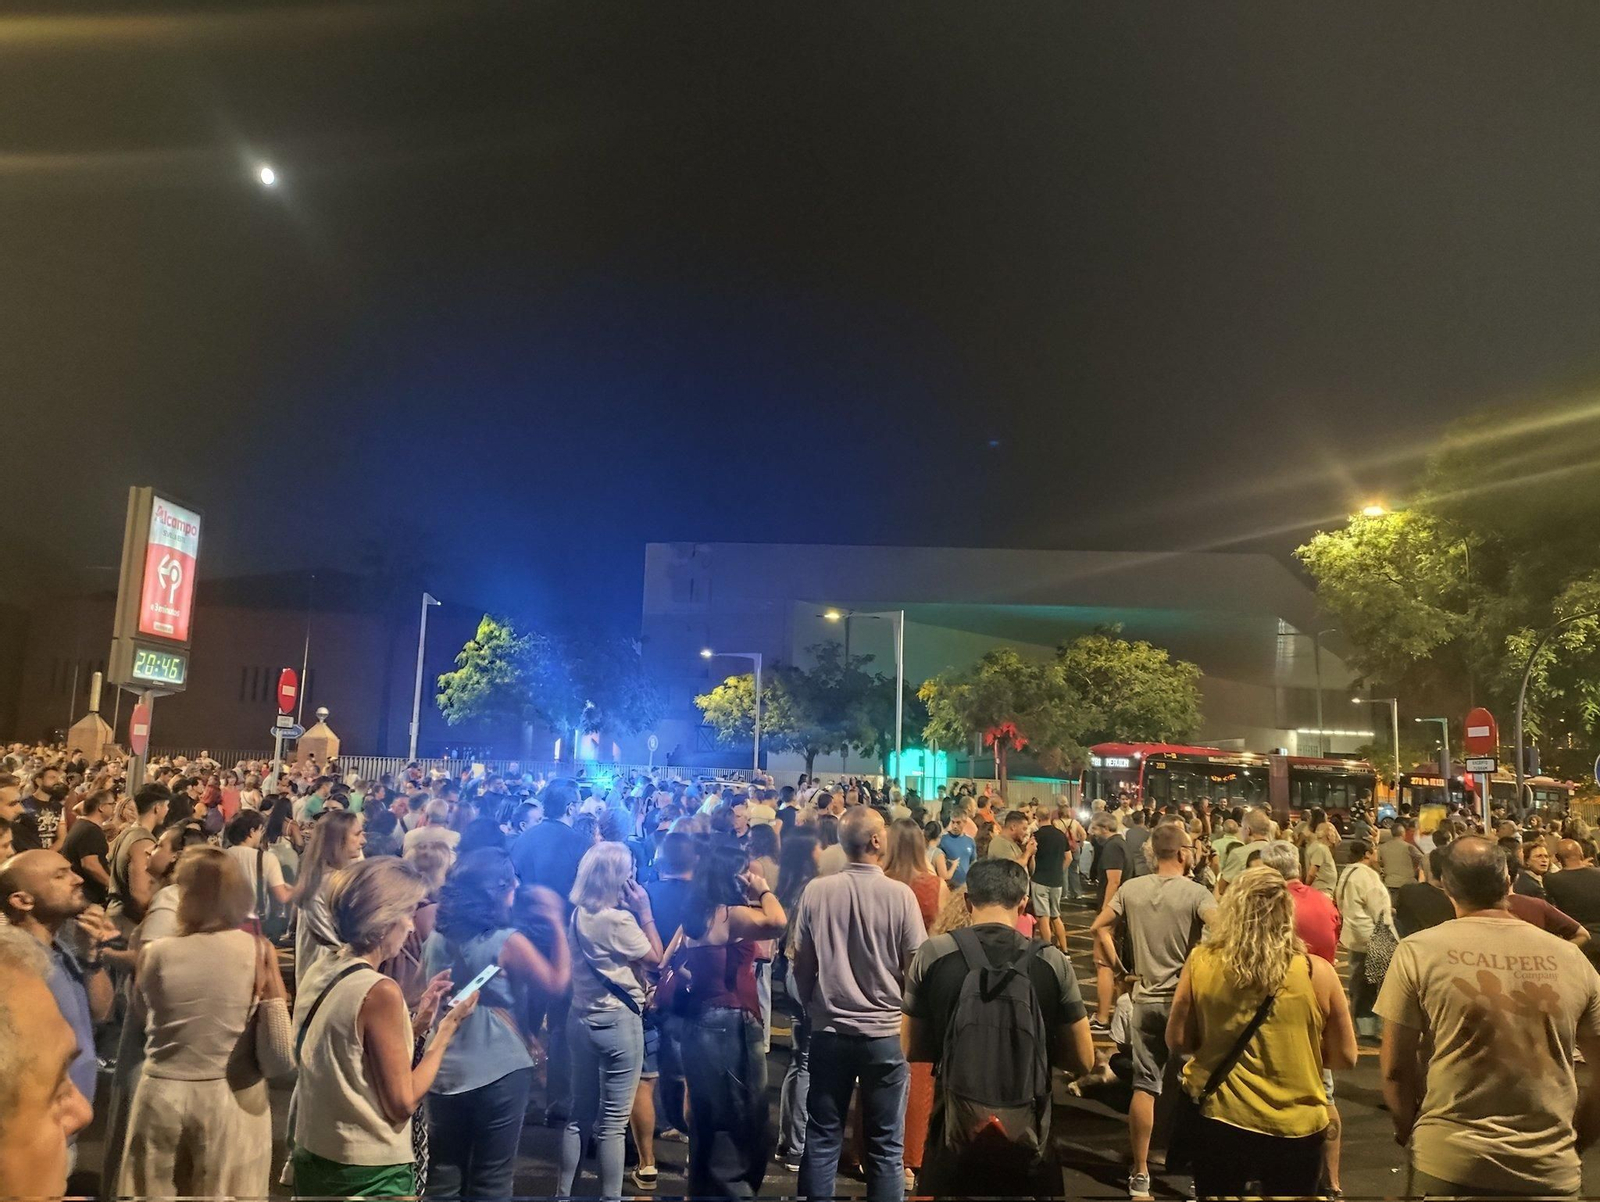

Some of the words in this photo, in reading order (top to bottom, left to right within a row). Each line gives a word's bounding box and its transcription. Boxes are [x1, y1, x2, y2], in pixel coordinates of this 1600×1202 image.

[156, 505, 197, 536] Alcampo
[134, 652, 180, 679] 20:46
[1447, 949, 1558, 971] SCALPERS
[1513, 970, 1559, 981] Company
